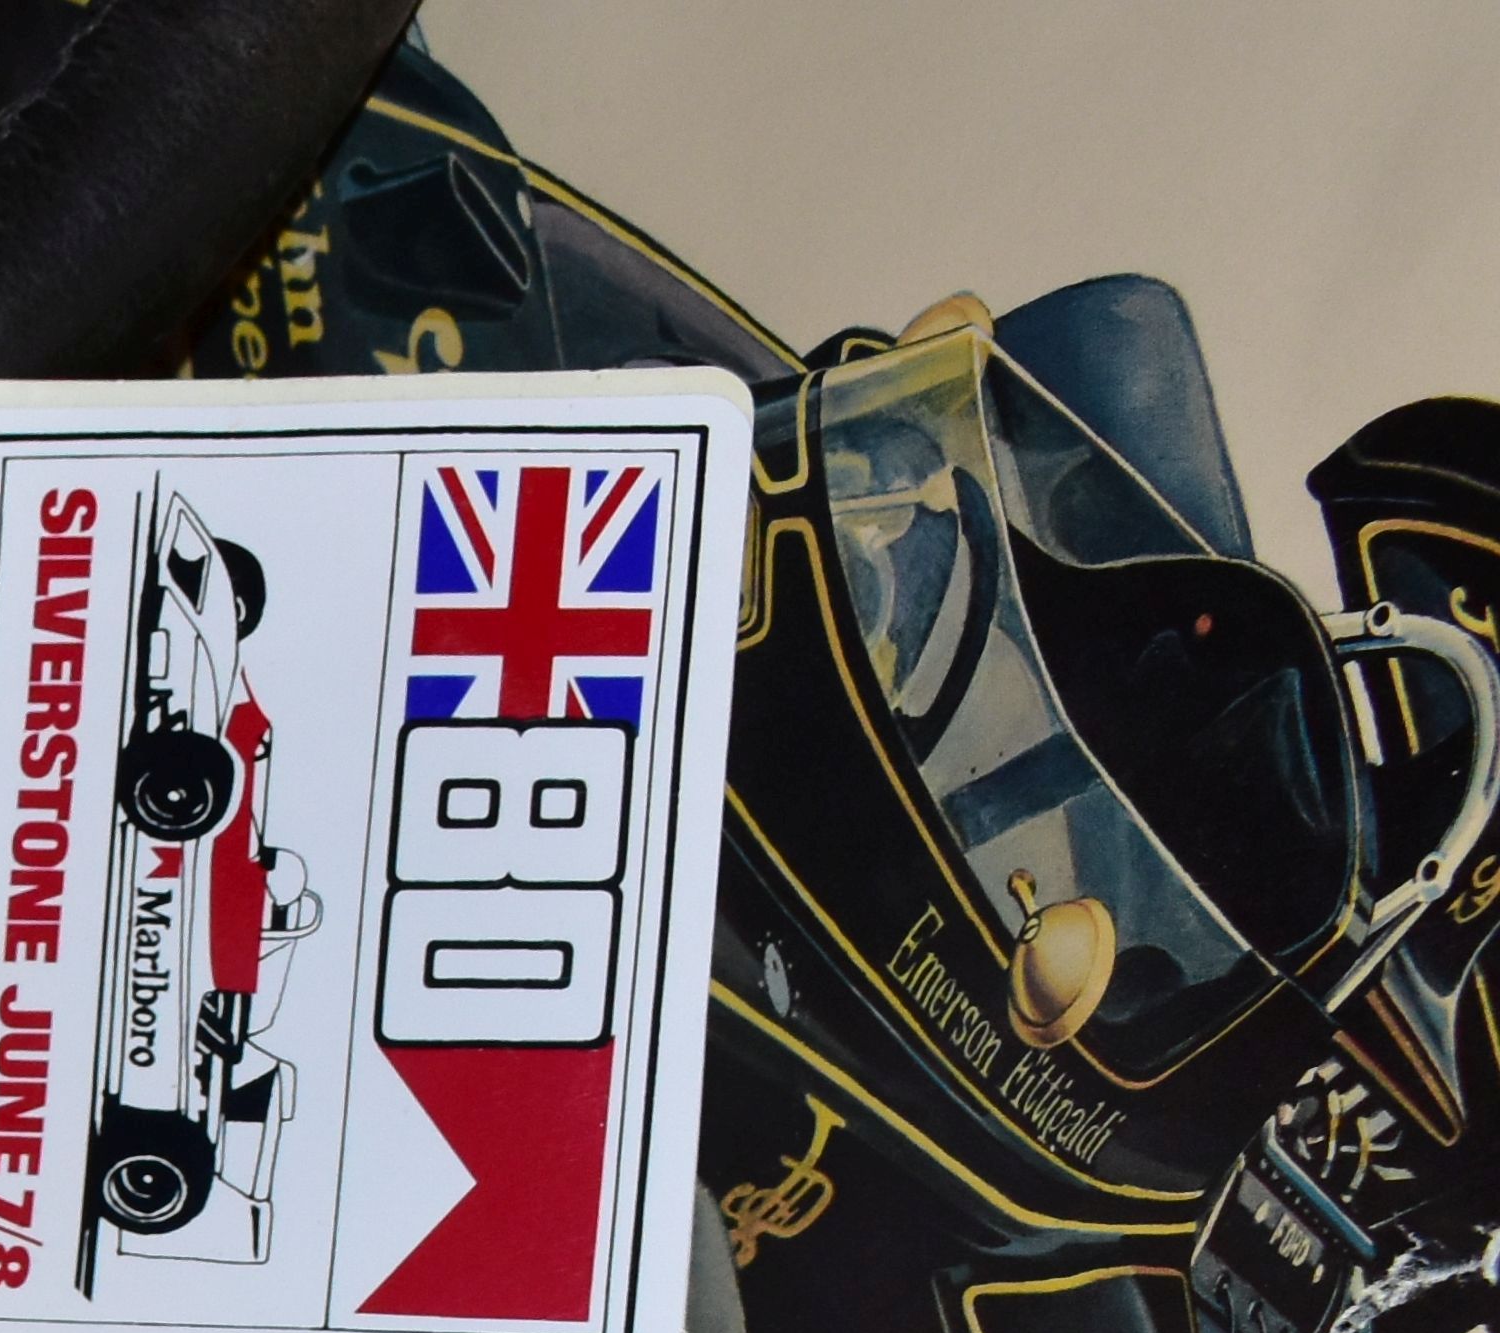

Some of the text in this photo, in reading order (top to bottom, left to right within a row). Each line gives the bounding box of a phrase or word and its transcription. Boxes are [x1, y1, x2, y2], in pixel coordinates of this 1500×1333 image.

[2, 487, 98, 965] SILVERSTONE
[126, 889, 175, 1070] Marlboro
[377, 718, 638, 1049] 80
[886, 901, 1127, 1165] Emerson Fittipaldi
